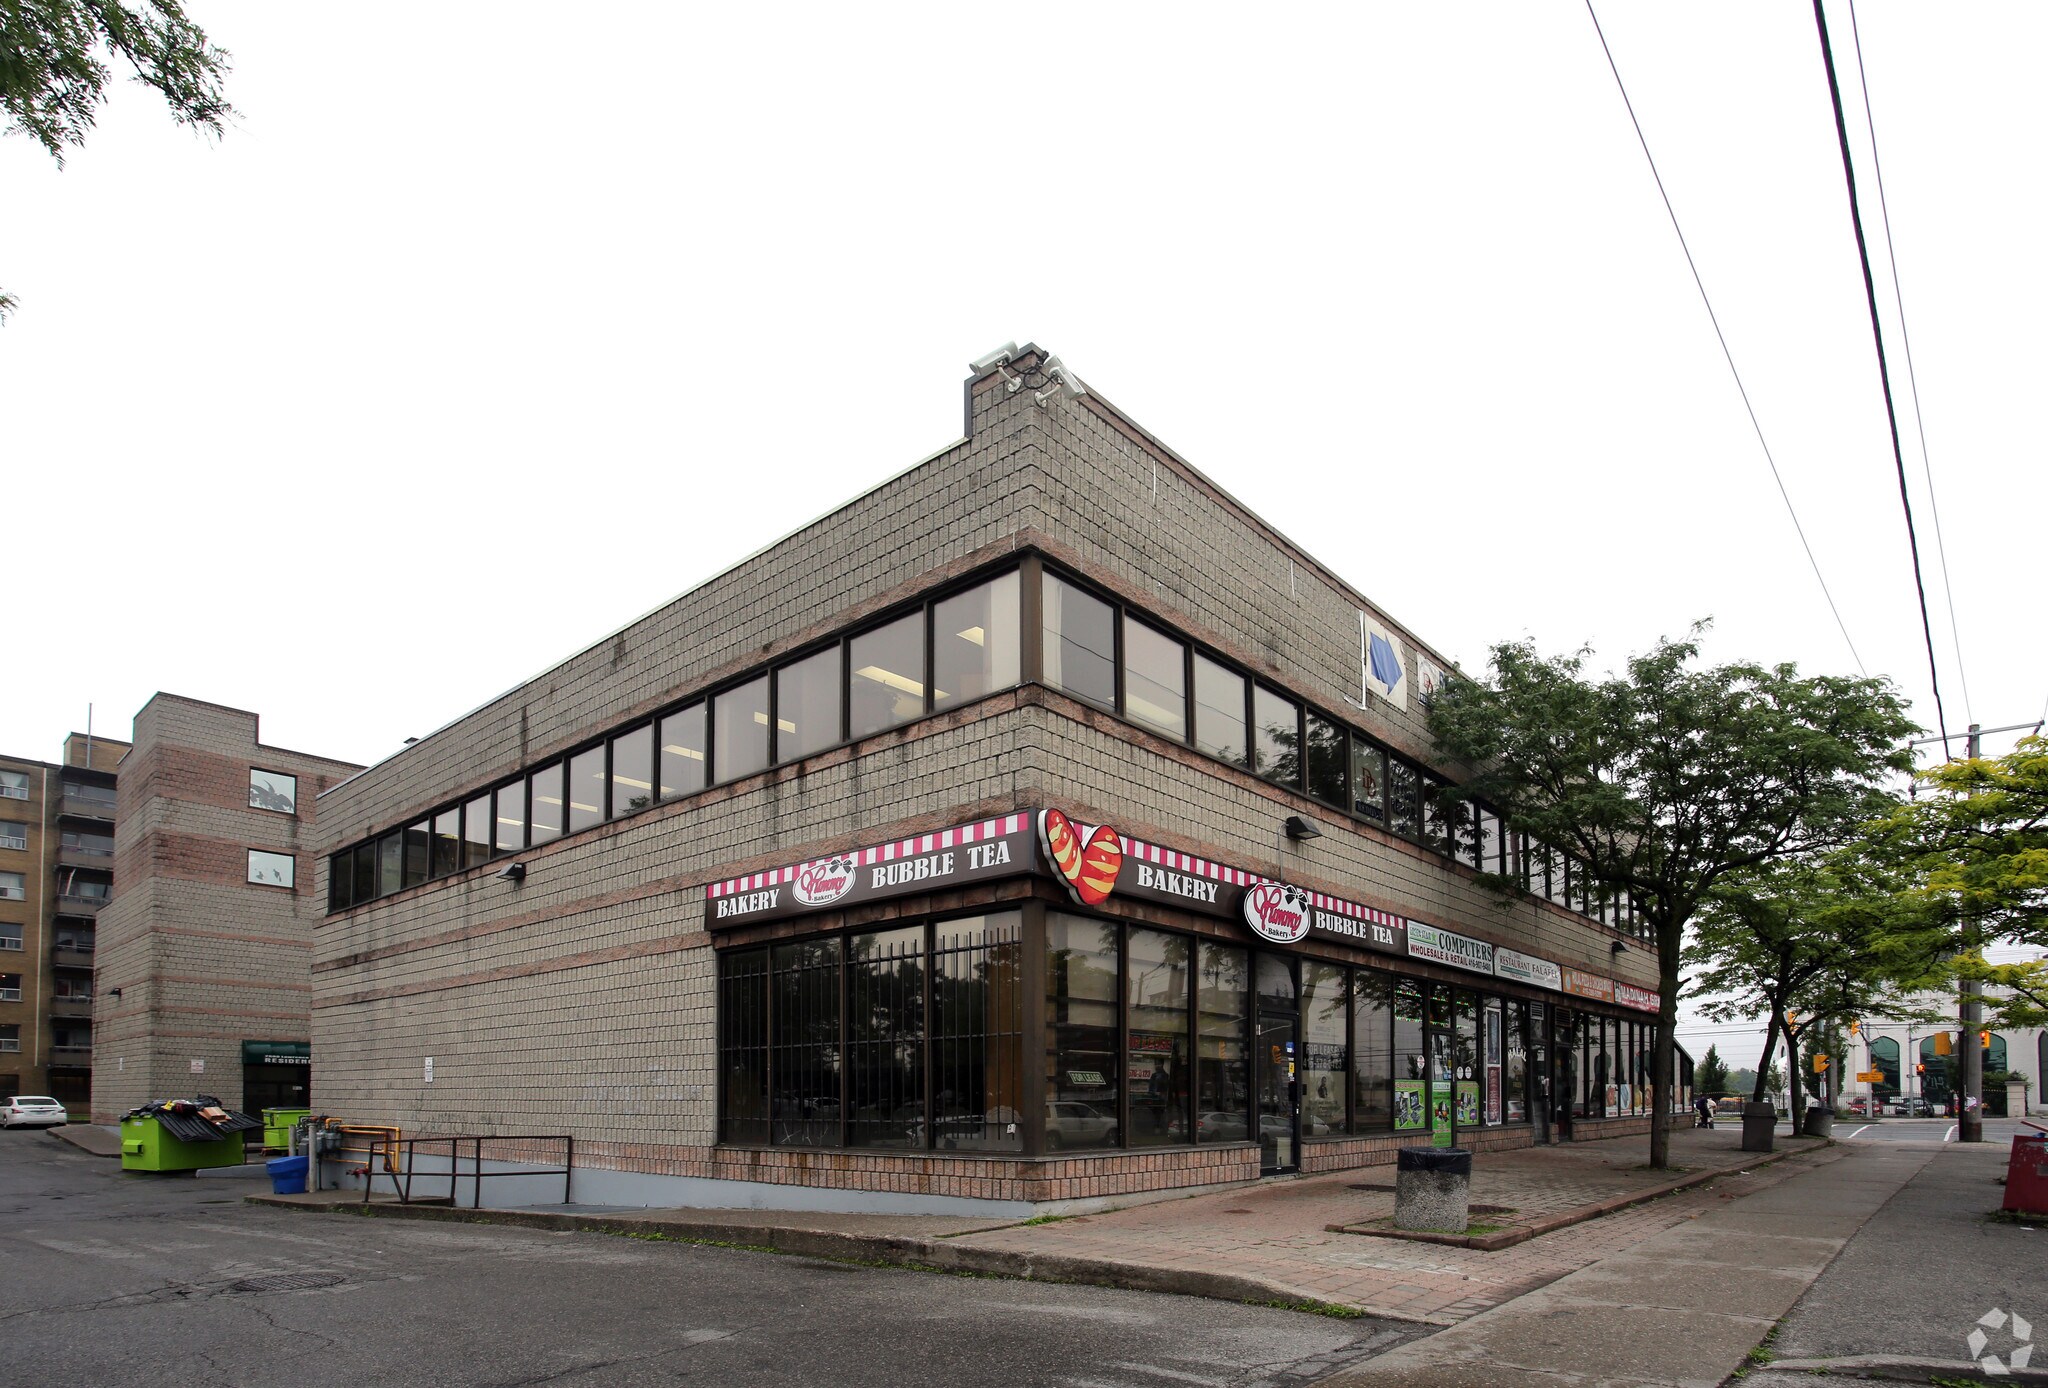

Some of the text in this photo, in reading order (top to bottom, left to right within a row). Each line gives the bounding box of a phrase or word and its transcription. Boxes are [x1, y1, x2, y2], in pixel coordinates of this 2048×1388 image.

[871, 840, 1012, 889] BUBBLE TEA
[801, 865, 847, 901] Yummy
[1137, 864, 1219, 904] BAKERY
[716, 888, 781, 919] BAKERY
[1253, 884, 1303, 937] Yummy
[1267, 927, 1289, 939] Bakery
[1314, 910, 1395, 946] BUBBLE TEA
[1410, 943, 1444, 960] WHOLESALE
[1445, 952, 1449, 961] &
[1450, 953, 1468, 967] RETAIL
[1438, 932, 1492, 962] COMPUTERS
[1499, 955, 1530, 971] RESTAURANT
[1531, 964, 1558, 979] FALAFEL
[1620, 984, 1649, 1004] MADINAH
[1507, 1046, 1527, 1062] HALAL
[1071, 1073, 1104, 1082] FOR LEASE
